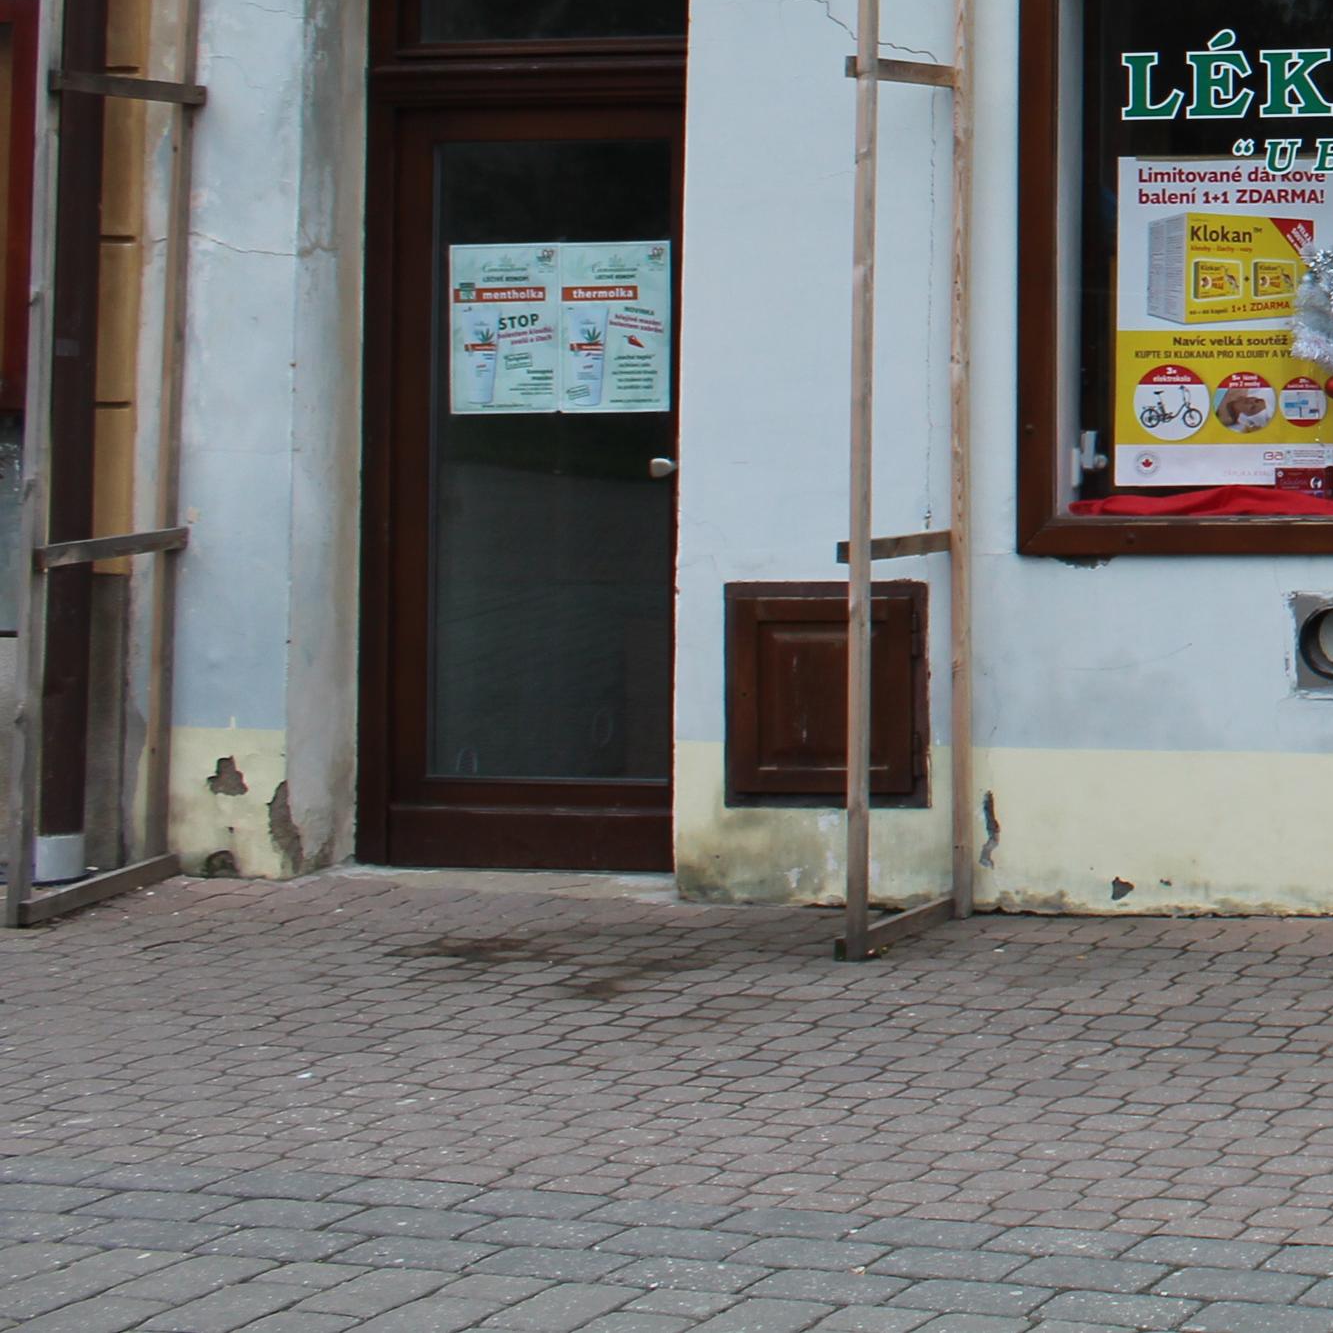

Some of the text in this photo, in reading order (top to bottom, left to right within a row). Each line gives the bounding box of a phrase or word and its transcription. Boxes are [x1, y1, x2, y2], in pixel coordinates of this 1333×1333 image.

[1138, 167, 1241, 183] Limitované
[1138, 187, 1324, 204] balení 1+1 ZDARMA!
[482, 289, 544, 299] mentholka
[572, 287, 633, 299] thermolka
[1250, 302, 1290, 312] ZDARMA
[498, 314, 540, 330] STOP
[1173, 335, 1288, 347] Navíc velká soutěž
[1135, 350, 1161, 359] KUPTE
[1164, 351, 1172, 359] SI
[1174, 350, 1214, 359] KLOKANA
[1217, 350, 1233, 359] PRO
[1236, 350, 1269, 359] KLOUBY
